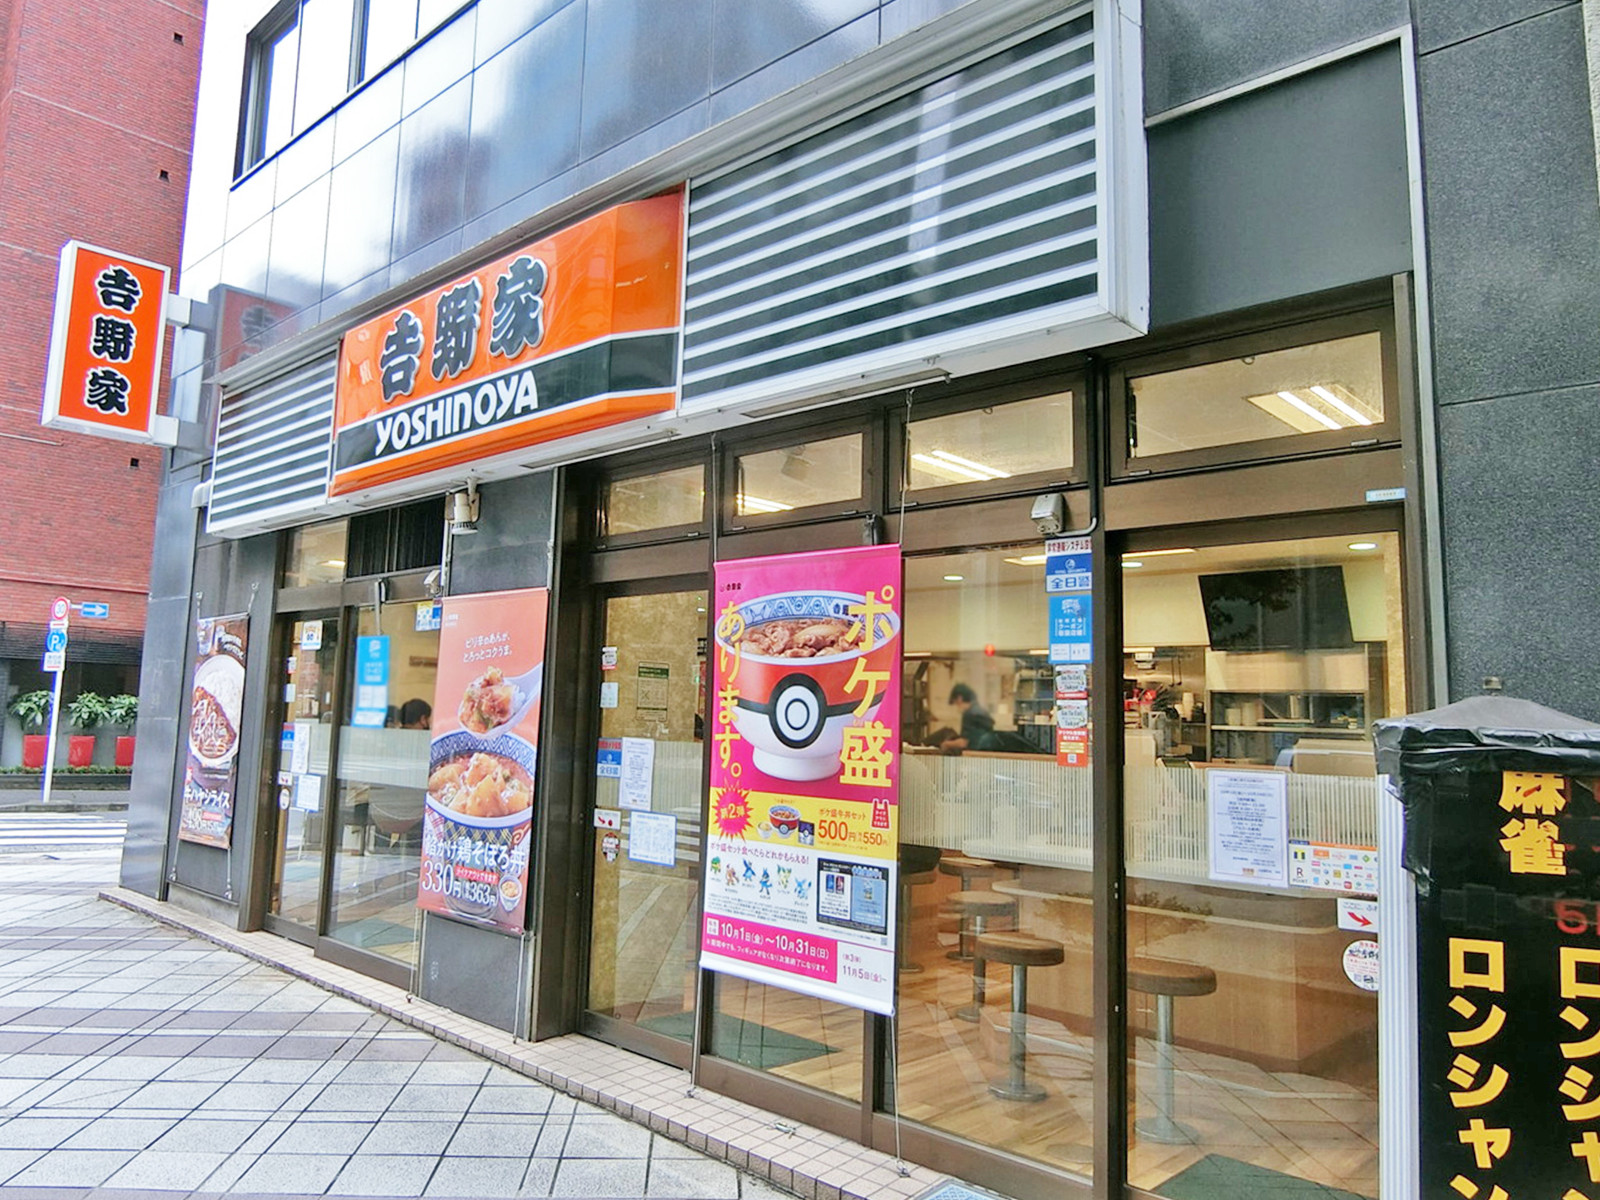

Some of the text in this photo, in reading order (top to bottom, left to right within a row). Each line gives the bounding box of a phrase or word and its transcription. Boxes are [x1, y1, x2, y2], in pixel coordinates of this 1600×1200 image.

[85, 265, 142, 415] 吉野家
[381, 256, 549, 403] 吉野家
[376, 370, 538, 456] YOSHINOYA
[715, 601, 746, 778] あります。
[839, 585, 894, 787] ポケ盛
[1498, 771, 1566, 875] 麻雀
